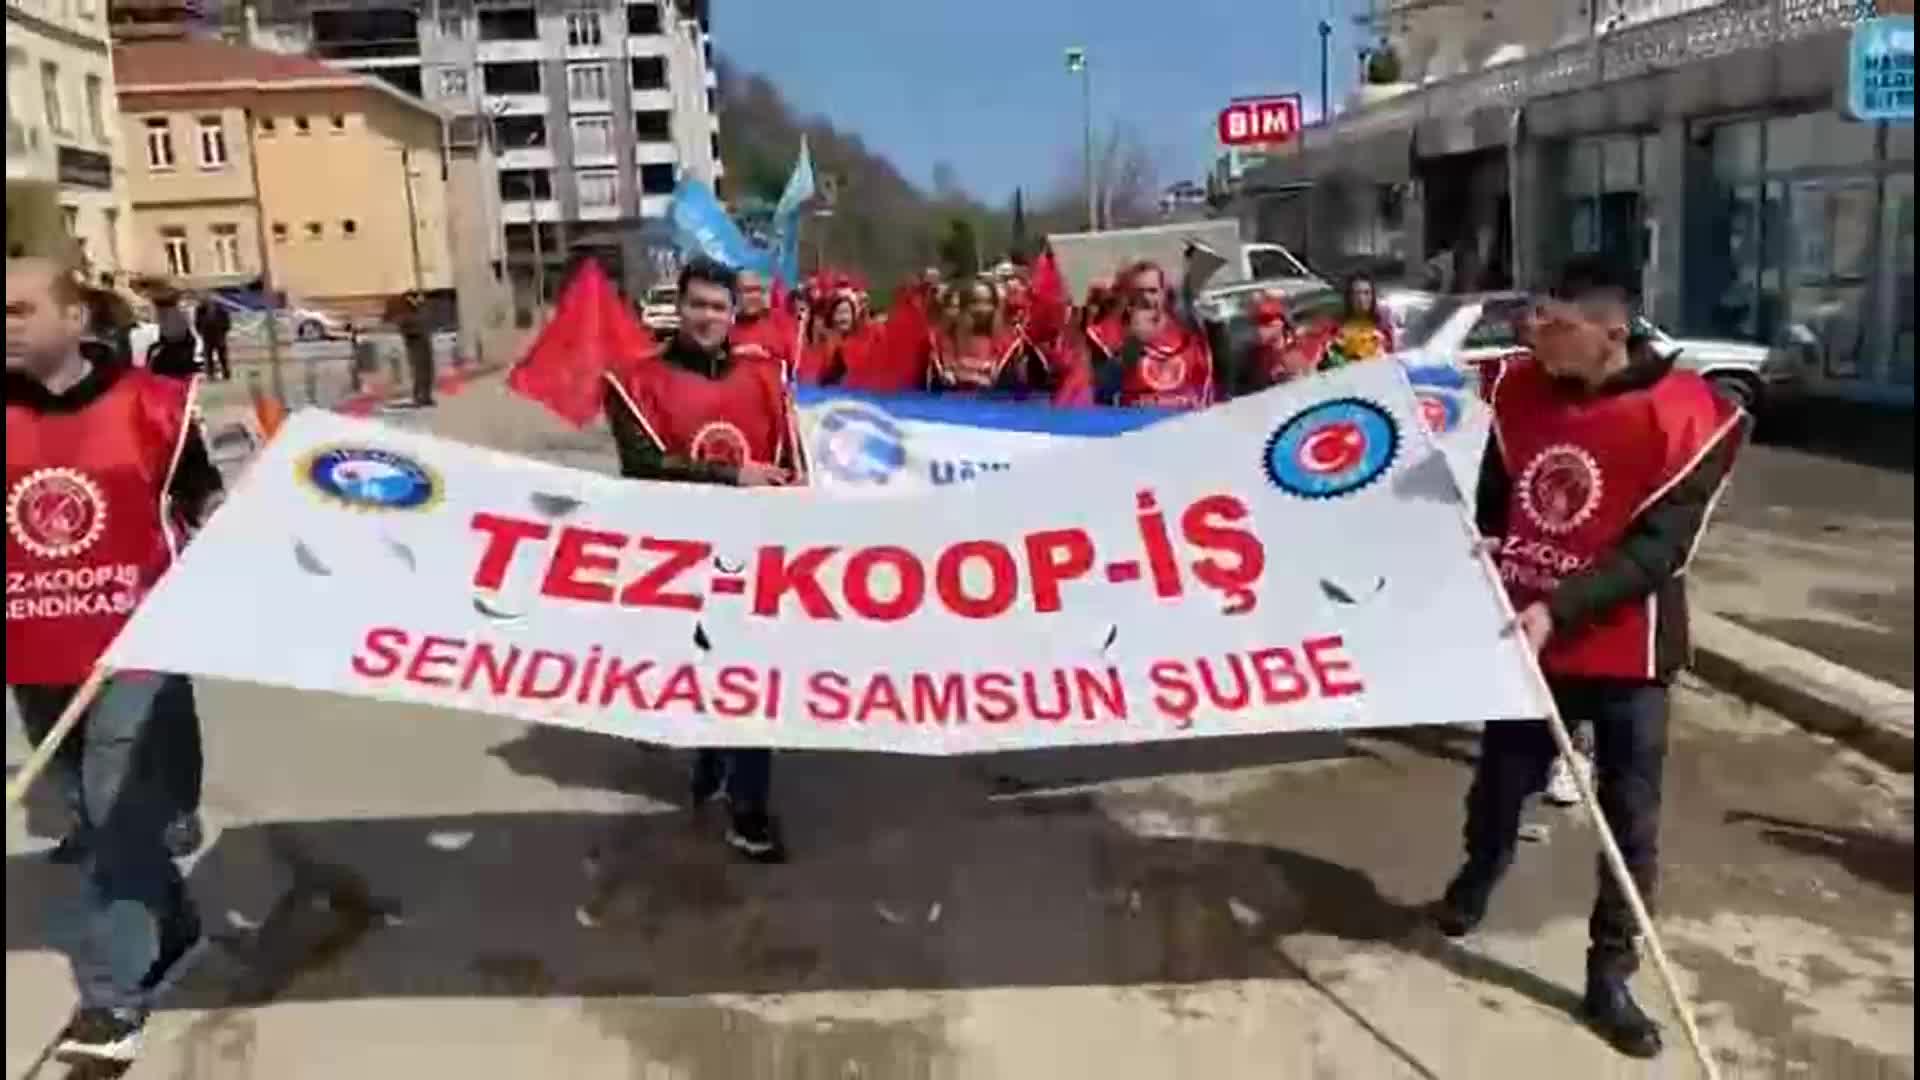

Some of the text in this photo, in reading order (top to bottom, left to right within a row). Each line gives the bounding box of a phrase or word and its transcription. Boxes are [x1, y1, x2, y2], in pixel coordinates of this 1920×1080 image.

[470, 489, 1265, 620] TEZ-KOOP-İŞ
[352, 626, 1364, 728] SENDİKASI SAMSUN ŞUBE
